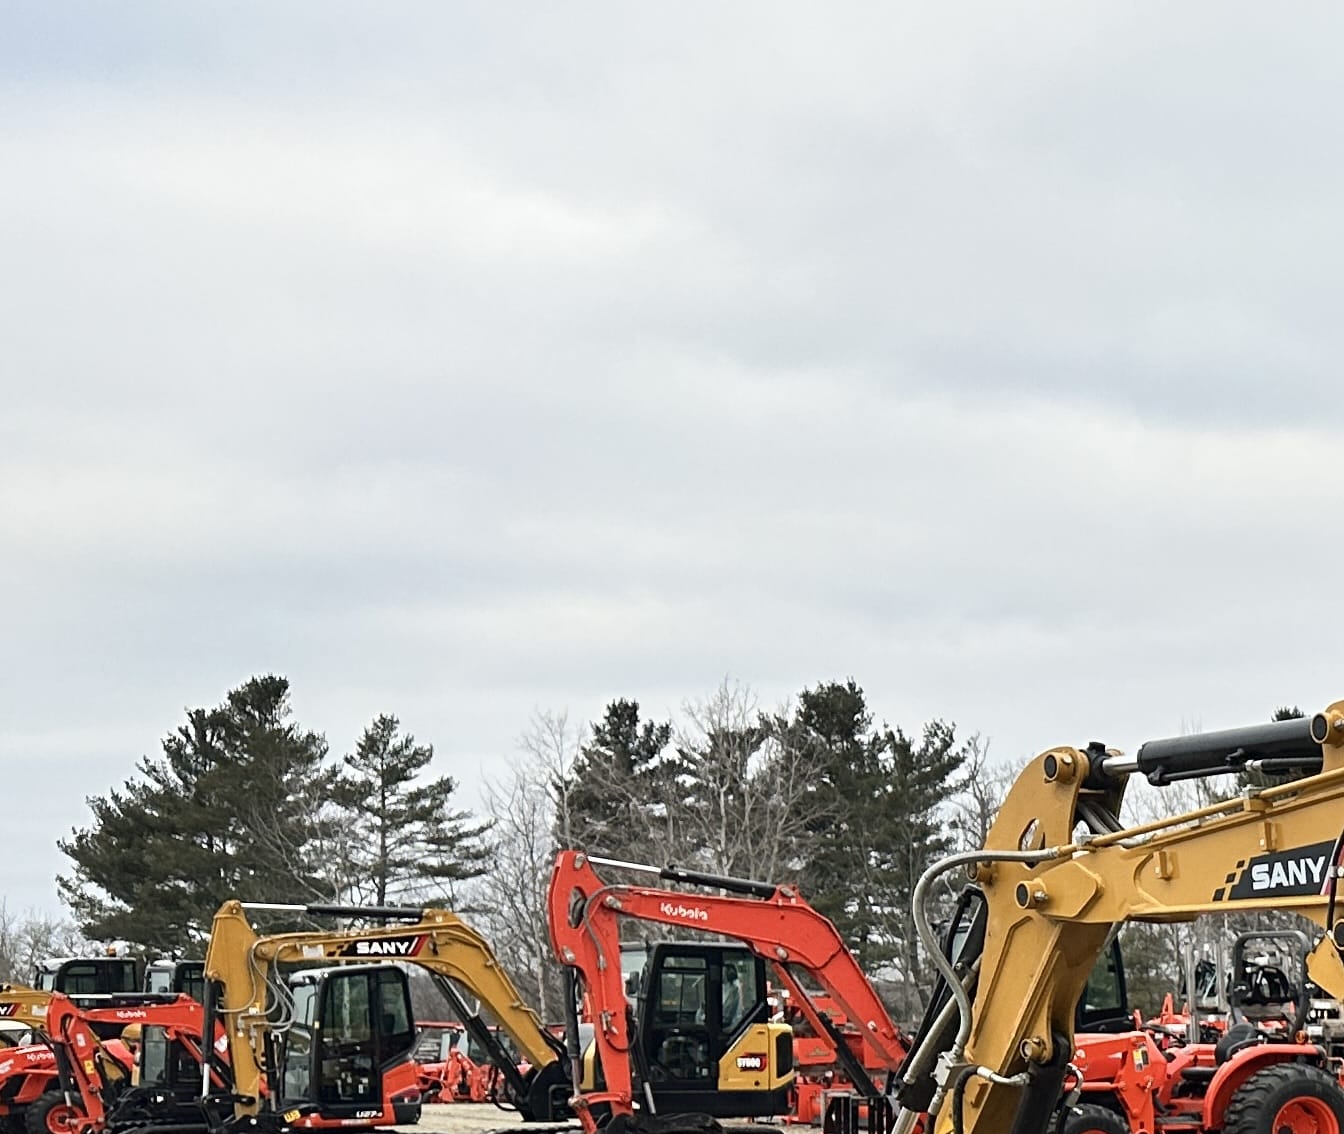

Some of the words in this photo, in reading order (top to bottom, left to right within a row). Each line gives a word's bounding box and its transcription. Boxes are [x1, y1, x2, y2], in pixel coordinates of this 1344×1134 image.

[1251, 855, 1326, 891] SANY
[659, 902, 709, 921] Kubota
[356, 941, 410, 955] SANY
